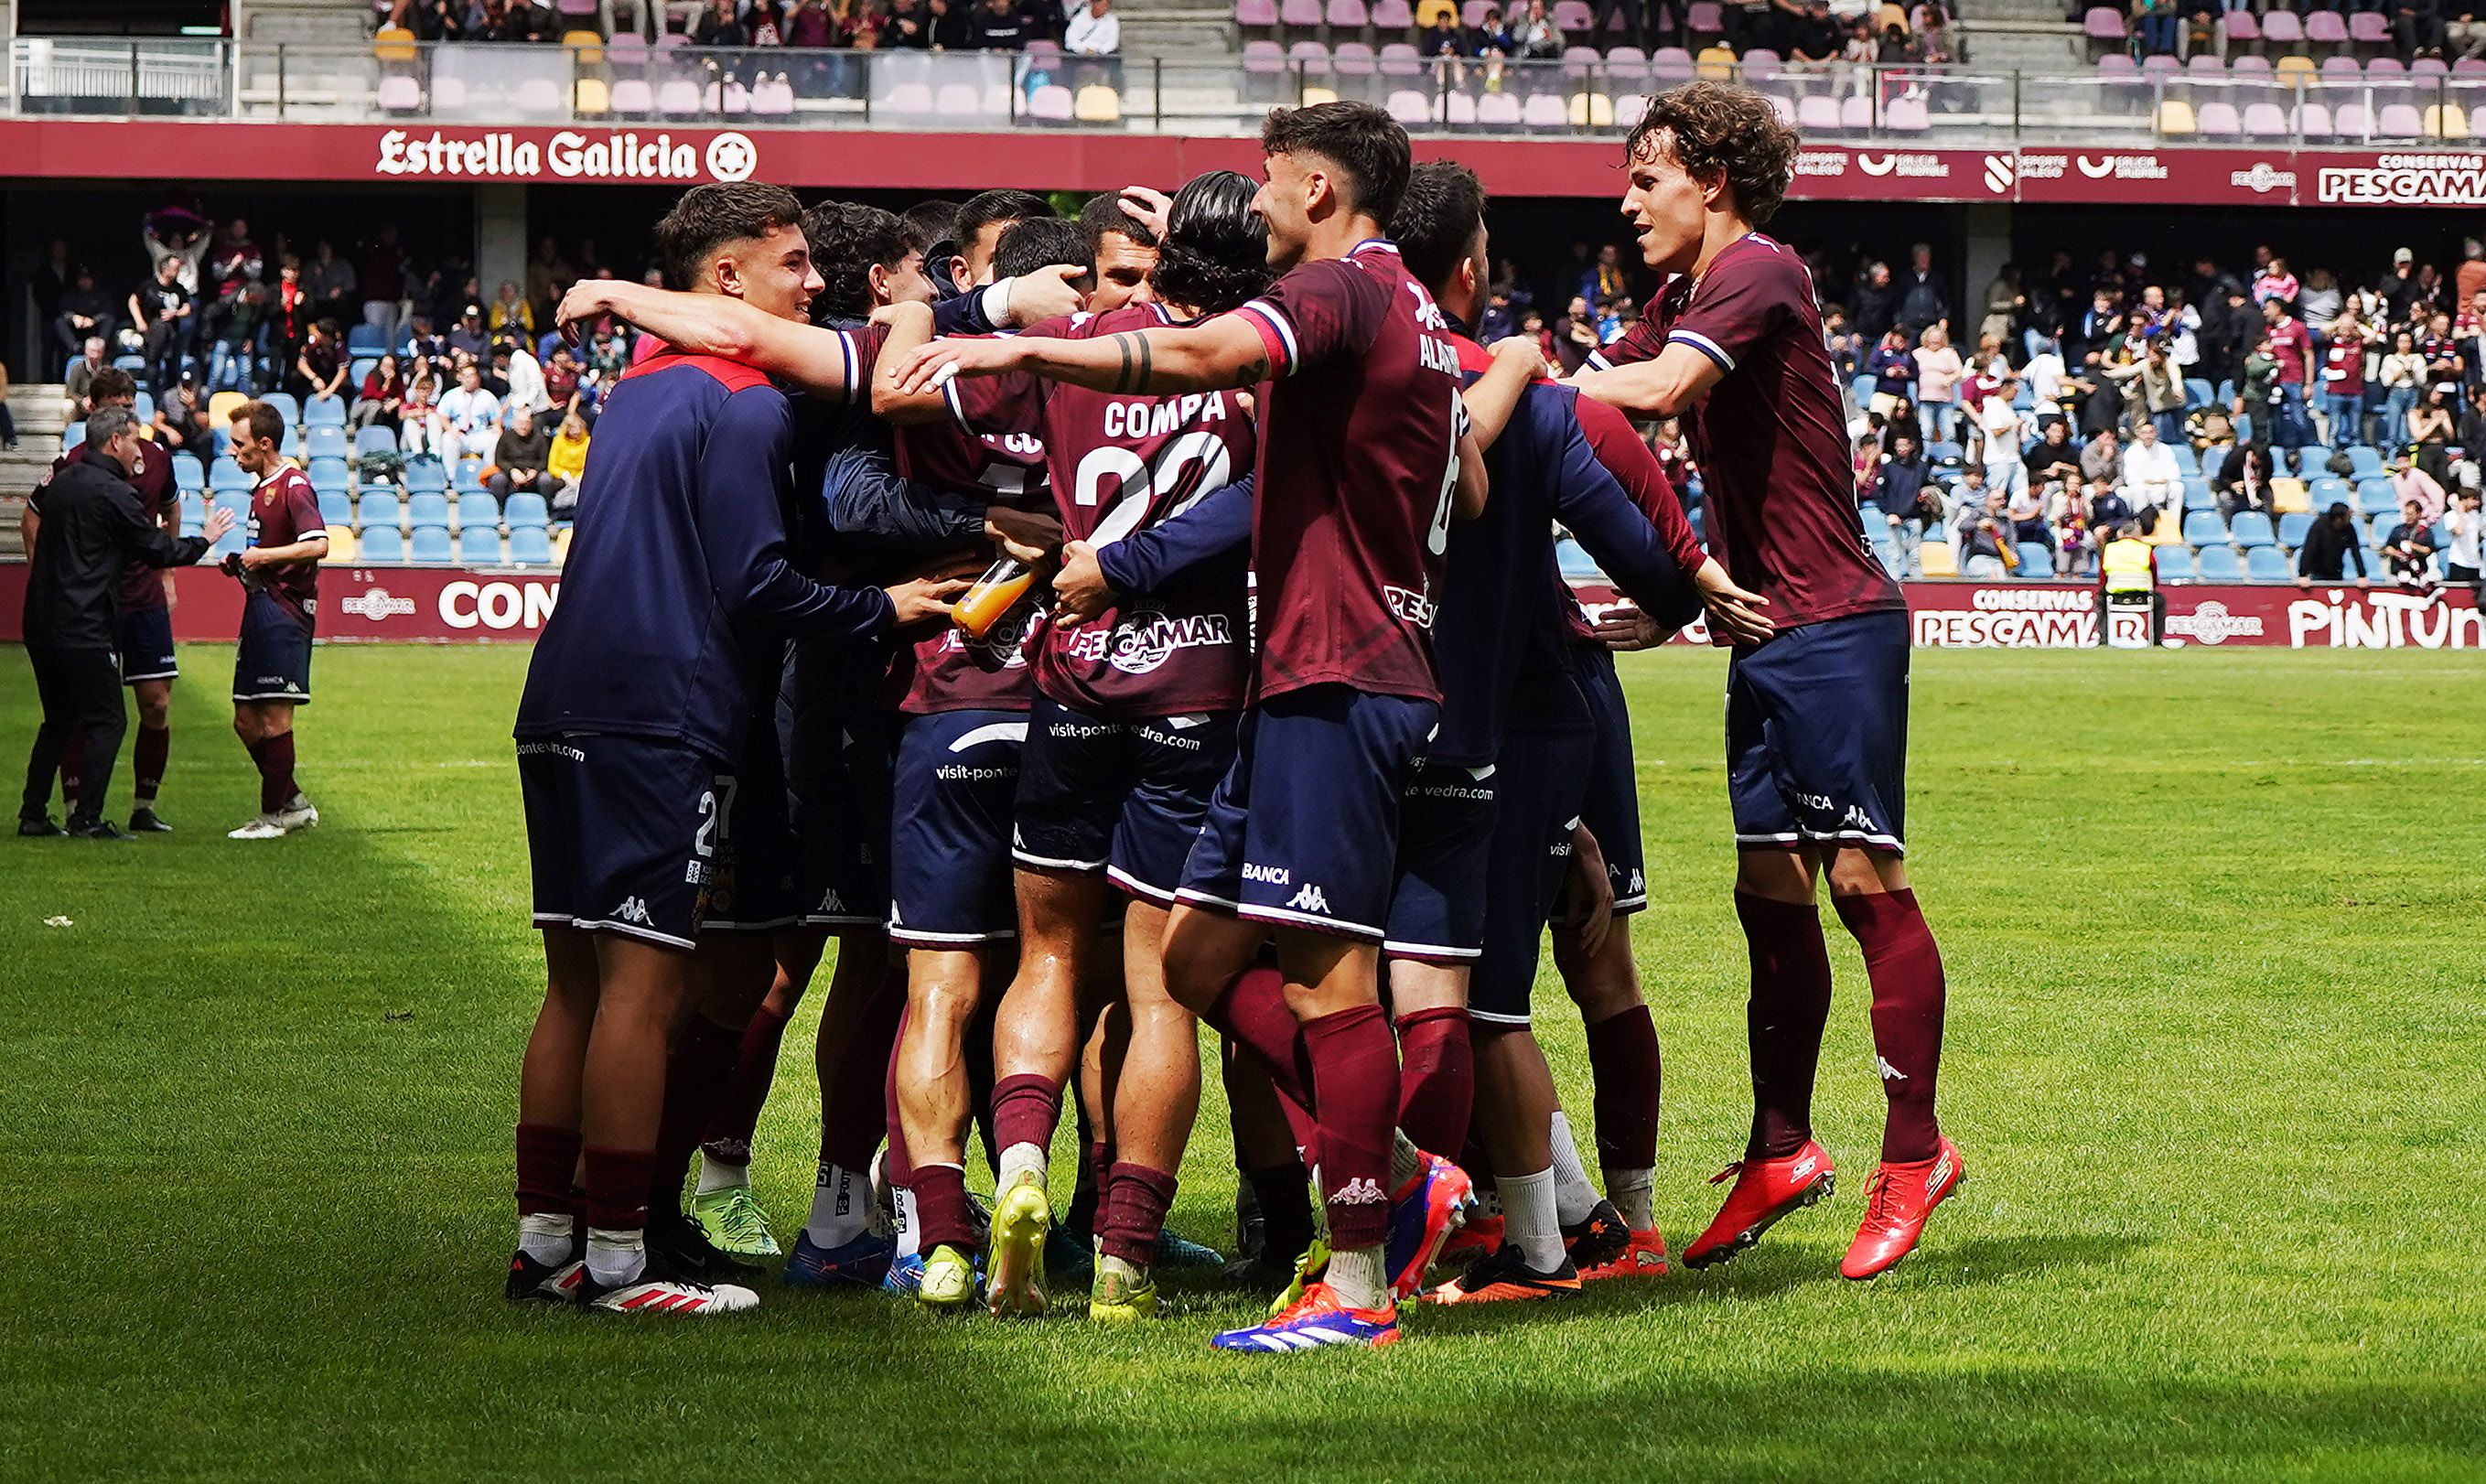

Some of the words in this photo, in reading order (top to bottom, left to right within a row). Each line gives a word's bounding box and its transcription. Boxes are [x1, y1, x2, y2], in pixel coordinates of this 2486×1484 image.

[376, 130, 541, 175] Estrella
[548, 131, 697, 177] Galicia
[2378, 155, 2483, 168] CONSERVAS
[2319, 168, 2486, 203] PESCAM
[1104, 390, 1226, 438] COMPA
[1075, 432, 1231, 553] 22
[1973, 589, 2093, 611] CONSERVAS
[1069, 614, 1232, 662] PECAMAR
